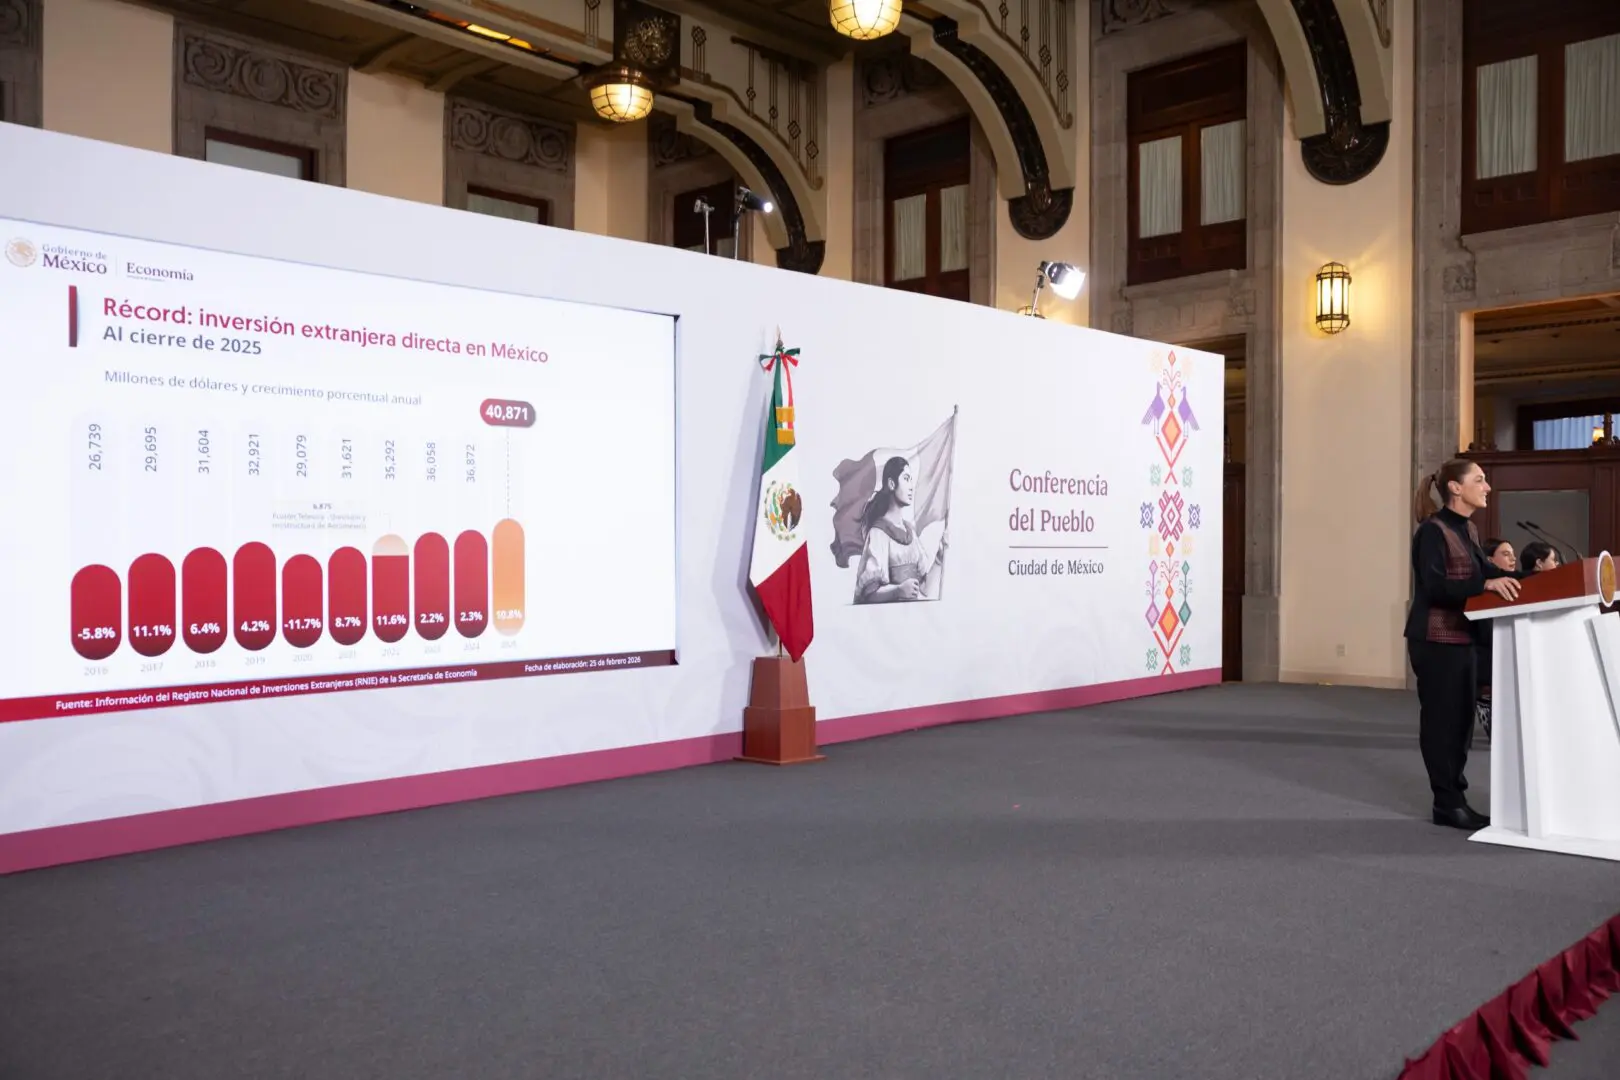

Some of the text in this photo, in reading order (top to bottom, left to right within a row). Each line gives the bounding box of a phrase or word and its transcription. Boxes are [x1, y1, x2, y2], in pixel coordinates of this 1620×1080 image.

[42, 243, 107, 260] Gobierno de
[42, 253, 107, 274] México
[126, 261, 194, 281] Economía
[103, 297, 549, 364] Récord: inversión extranjera directa en México
[103, 325, 262, 355] Al cierre de 2025
[104, 369, 422, 406] Millones de dólares y crecimiento porcentual anual
[485, 404, 529, 422] 40,871
[88, 423, 102, 471] 26,739
[144, 426, 157, 472] 29,695
[198, 429, 210, 475] 31,604
[248, 433, 260, 476] 32,921
[296, 434, 307, 477] 29,079
[341, 437, 352, 480] 31,621
[385, 439, 396, 481] 35,292
[426, 441, 437, 481] 36,058
[465, 443, 476, 483] 36,872
[1009, 468, 1108, 496] Conferencia
[1009, 507, 1094, 533] del Pueblo
[1008, 558, 1104, 576] Ciudad de México
[241, 620, 269, 632] 4.2%
[284, 618, 321, 630] -11.7%
[335, 616, 361, 628] 8.7%
[376, 614, 407, 626] 11.6%
[420, 612, 444, 624] 2.2%
[460, 611, 483, 622] 2.3%
[78, 626, 116, 640] -5.8%
[133, 624, 172, 638] 11.1%
[190, 622, 220, 635] 6.4%
[140, 663, 164, 673] 2017
[244, 656, 266, 666] 2019
[524, 655, 641, 673] Fecha de elaboración: 25 de febrero 2026
[55, 667, 478, 710] Fuente: Información del Registro Nacional de Inversiones Extranjeras (RNIE) de la Secretaría de Economía
